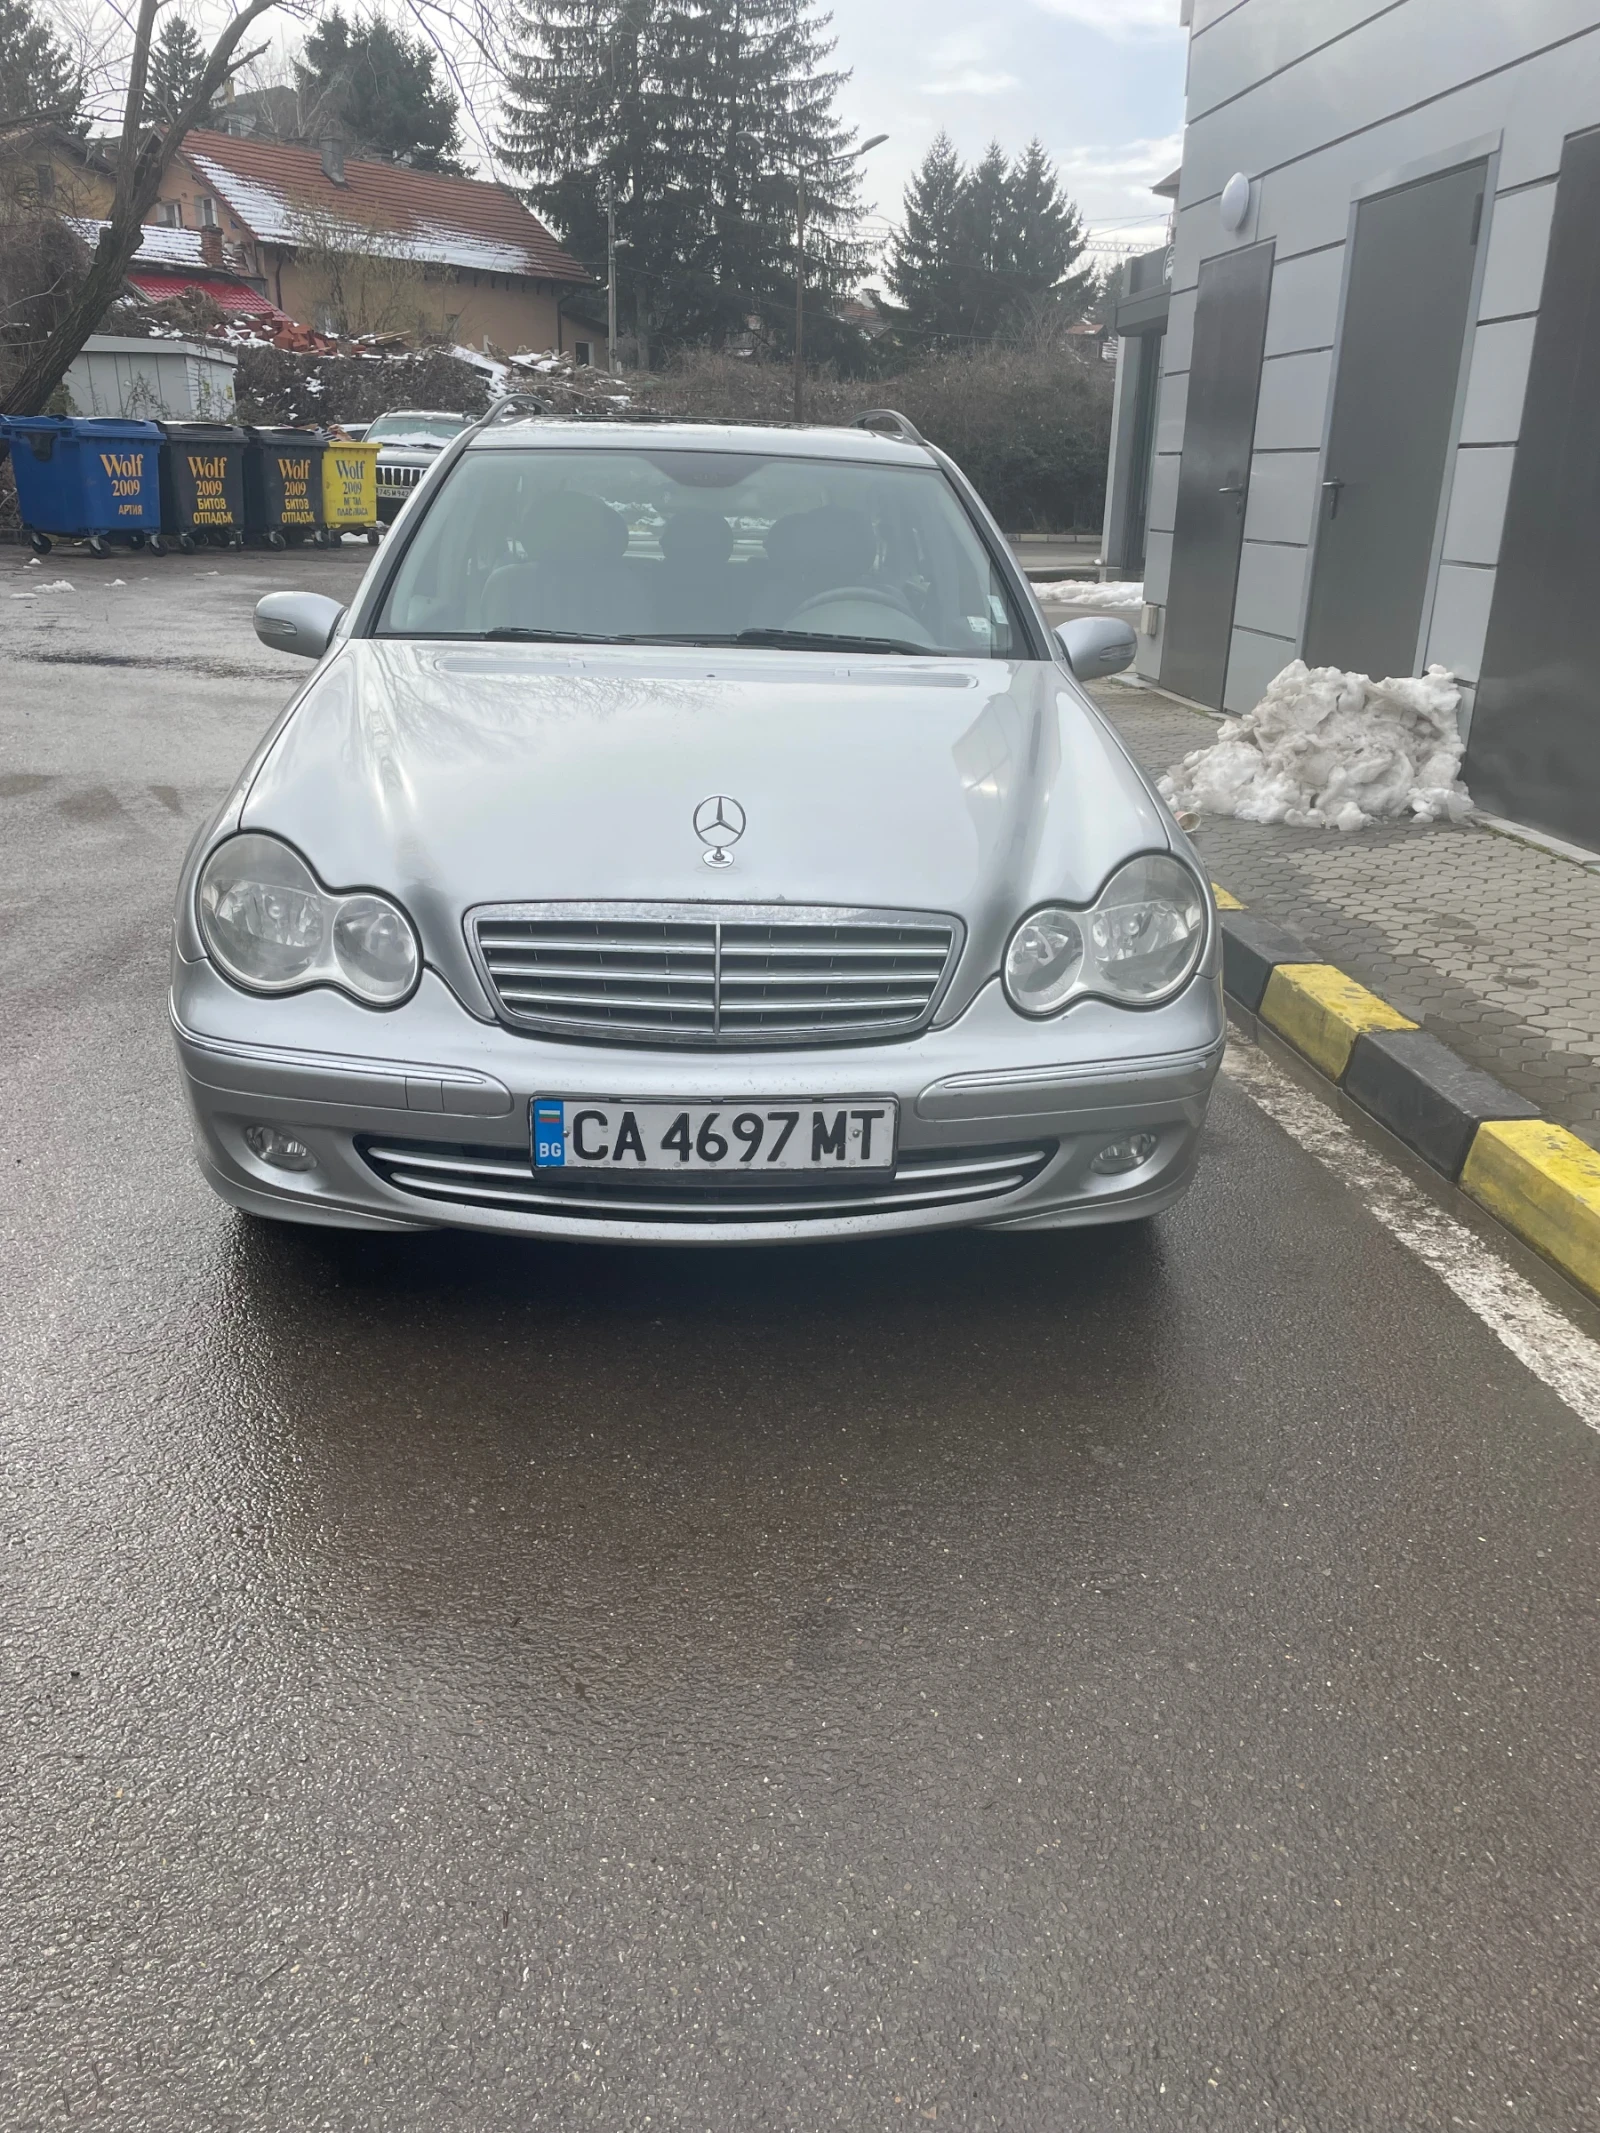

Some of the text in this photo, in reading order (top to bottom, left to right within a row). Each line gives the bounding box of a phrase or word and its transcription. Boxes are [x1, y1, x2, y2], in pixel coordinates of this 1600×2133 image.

[99, 453, 144, 478] Wolf
[187, 456, 228, 479] Wolf
[277, 458, 311, 480] Wolf
[335, 460, 366, 480] Wolf
[111, 479, 141, 497] 2009
[195, 480, 223, 496] 2009
[284, 481, 307, 496] 2009
[342, 481, 362, 495] 2009
[118, 504, 143, 516] АРТИЯ
[197, 497, 227, 511] БИТОВ
[285, 498, 310, 510] БИТОВ
[193, 511, 234, 526] ОТПАДЪК
[281, 511, 316, 525] ОТПАДЪК
[572, 1109, 886, 1163] CA 4697 MT
[538, 1142, 562, 1158] BG
